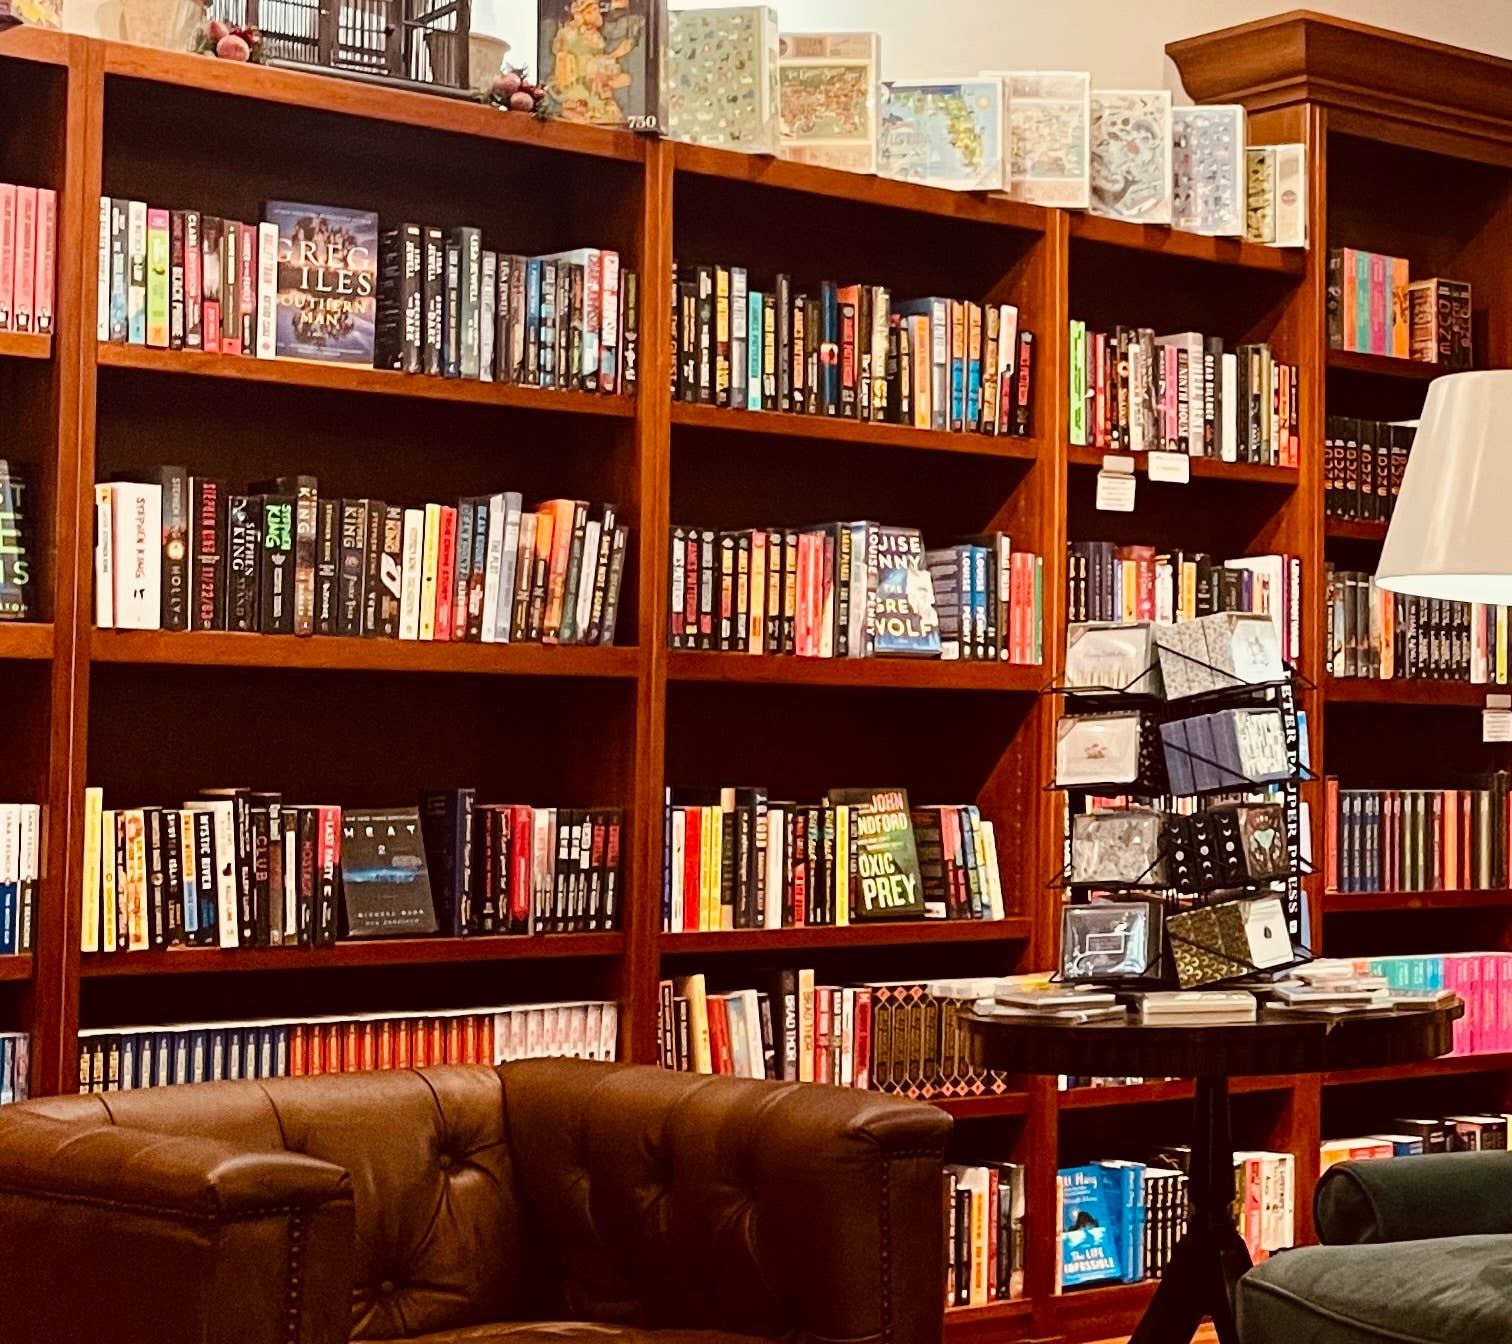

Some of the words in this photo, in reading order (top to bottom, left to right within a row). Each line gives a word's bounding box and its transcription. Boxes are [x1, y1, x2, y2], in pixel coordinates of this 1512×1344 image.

[627, 114, 657, 129] 750
[277, 236, 370, 272] GREG
[299, 266, 373, 297] ILES
[300, 310, 341, 327] MAN
[265, 505, 281, 549] KING
[298, 487, 310, 534] KING
[343, 506, 356, 548] KING
[135, 548, 146, 579] KING
[232, 526, 245, 571] KING
[868, 527, 879, 574] LOUISE
[170, 565, 181, 616] HOLLY
[961, 552, 971, 592] LOUISE
[975, 552, 985, 592] LOUISE
[866, 592, 876, 637] PENNY
[961, 606, 971, 644] PENNY
[975, 606, 985, 644] PENNY
[1281, 684, 1298, 744] ETER
[869, 791, 904, 814] JOHN
[200, 815, 210, 854] MYSTIC
[857, 812, 908, 836] NDFORD
[201, 857, 212, 890] RIVER
[256, 835, 268, 882] CLUB
[858, 852, 896, 879] OXIC
[862, 873, 916, 911] PREY
[785, 994, 795, 1027] BRAD
[785, 1029, 797, 1061] THOR
